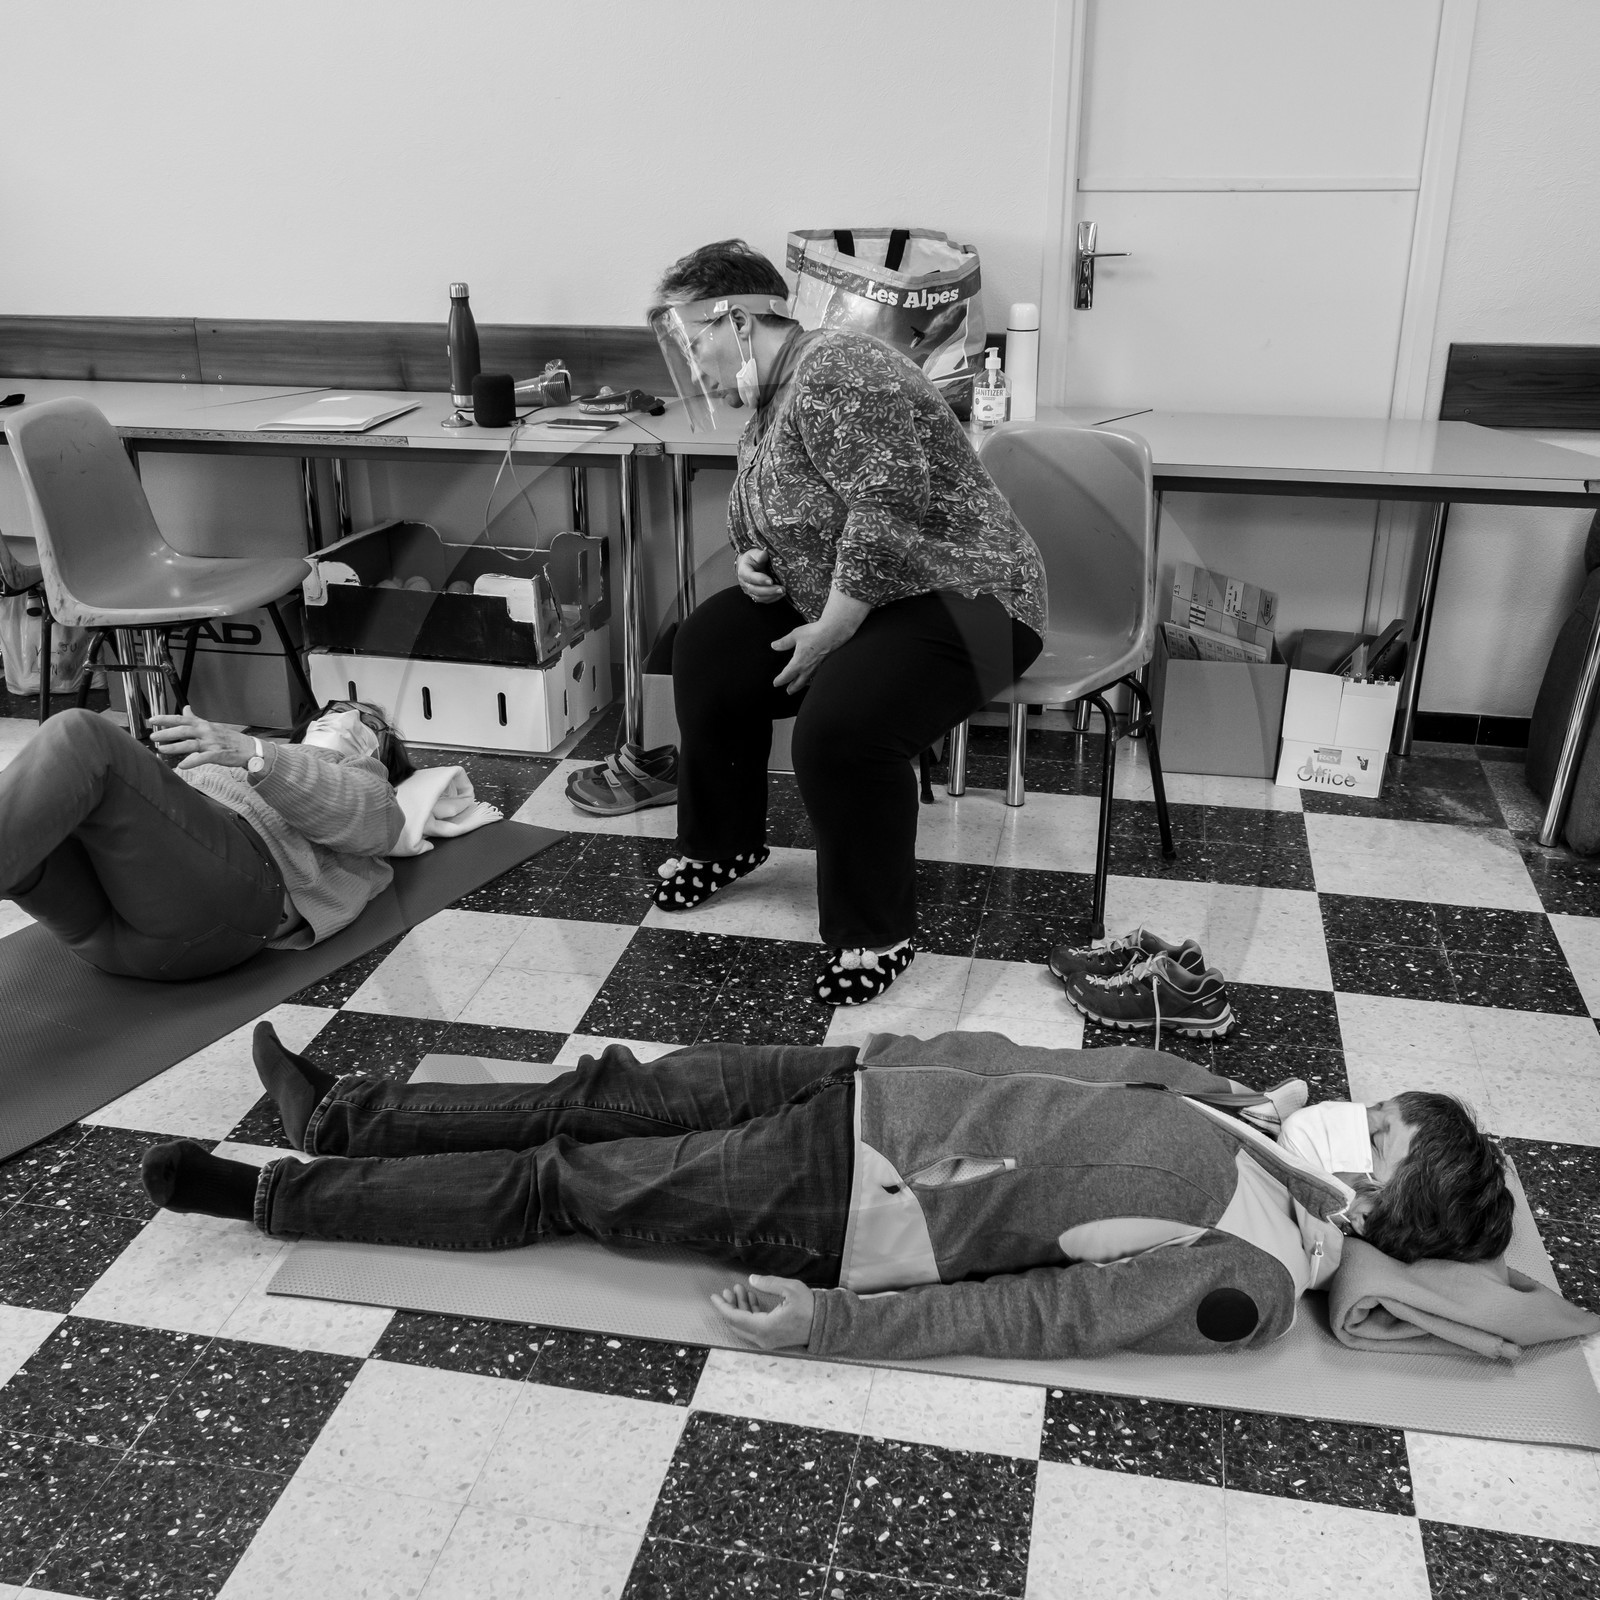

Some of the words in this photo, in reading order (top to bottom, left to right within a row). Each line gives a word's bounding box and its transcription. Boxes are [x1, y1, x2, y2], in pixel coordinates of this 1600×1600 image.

[865, 280, 899, 306] Les
[902, 288, 960, 310] Alpes
[975, 388, 1004, 396] SANITIZER
[1297, 765, 1357, 787] Office
